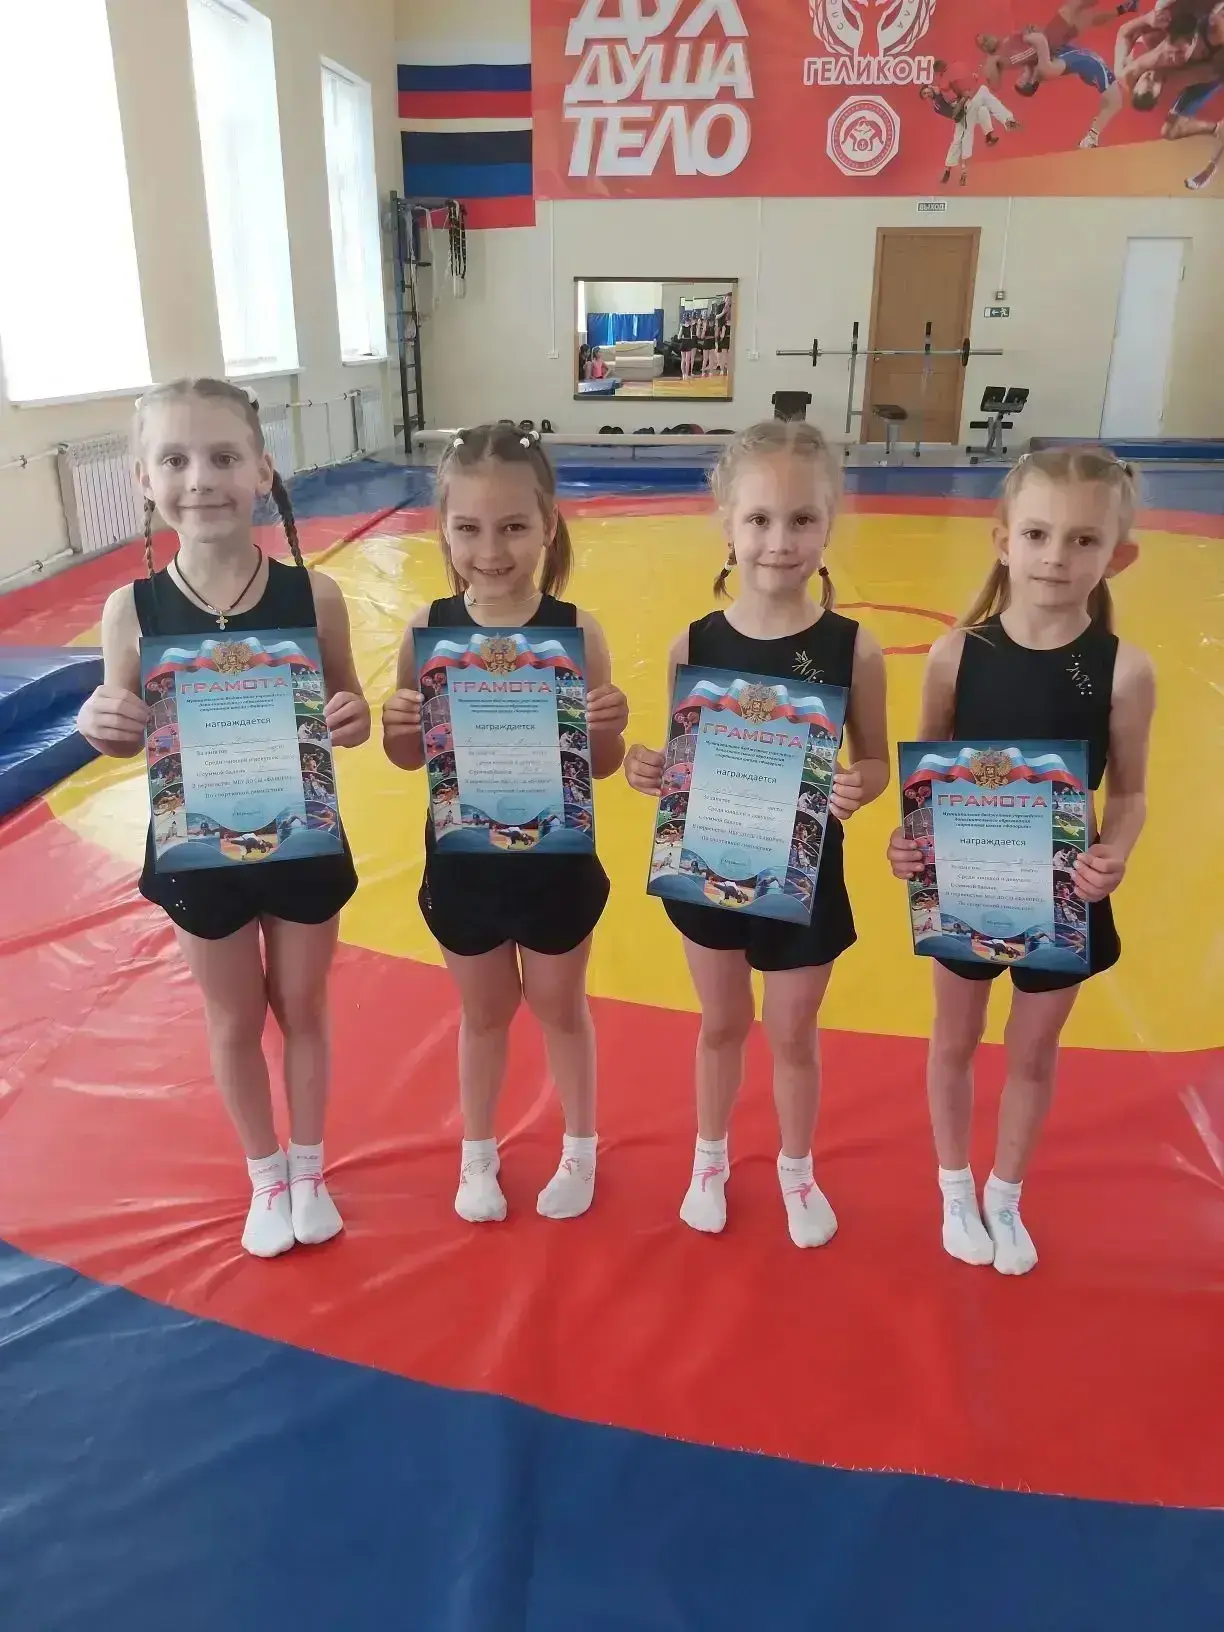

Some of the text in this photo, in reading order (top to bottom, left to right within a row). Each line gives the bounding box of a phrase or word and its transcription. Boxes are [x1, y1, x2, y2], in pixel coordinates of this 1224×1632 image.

[563, 43, 754, 104] ДУША
[804, 56, 935, 85] ГЕЛИКОН
[564, 104, 750, 177] ТЕЛО
[918, 202, 946, 211] ВЫХОД
[181, 677, 288, 694] ГРАМОТА
[453, 682, 552, 693] ГРАМОТА
[205, 717, 271, 729] награждается
[703, 722, 802, 749] ГРАМОТА
[716, 768, 777, 784] награждается
[938, 795, 1047, 807] ГРАМОТА
[960, 838, 1026, 848] награждается
